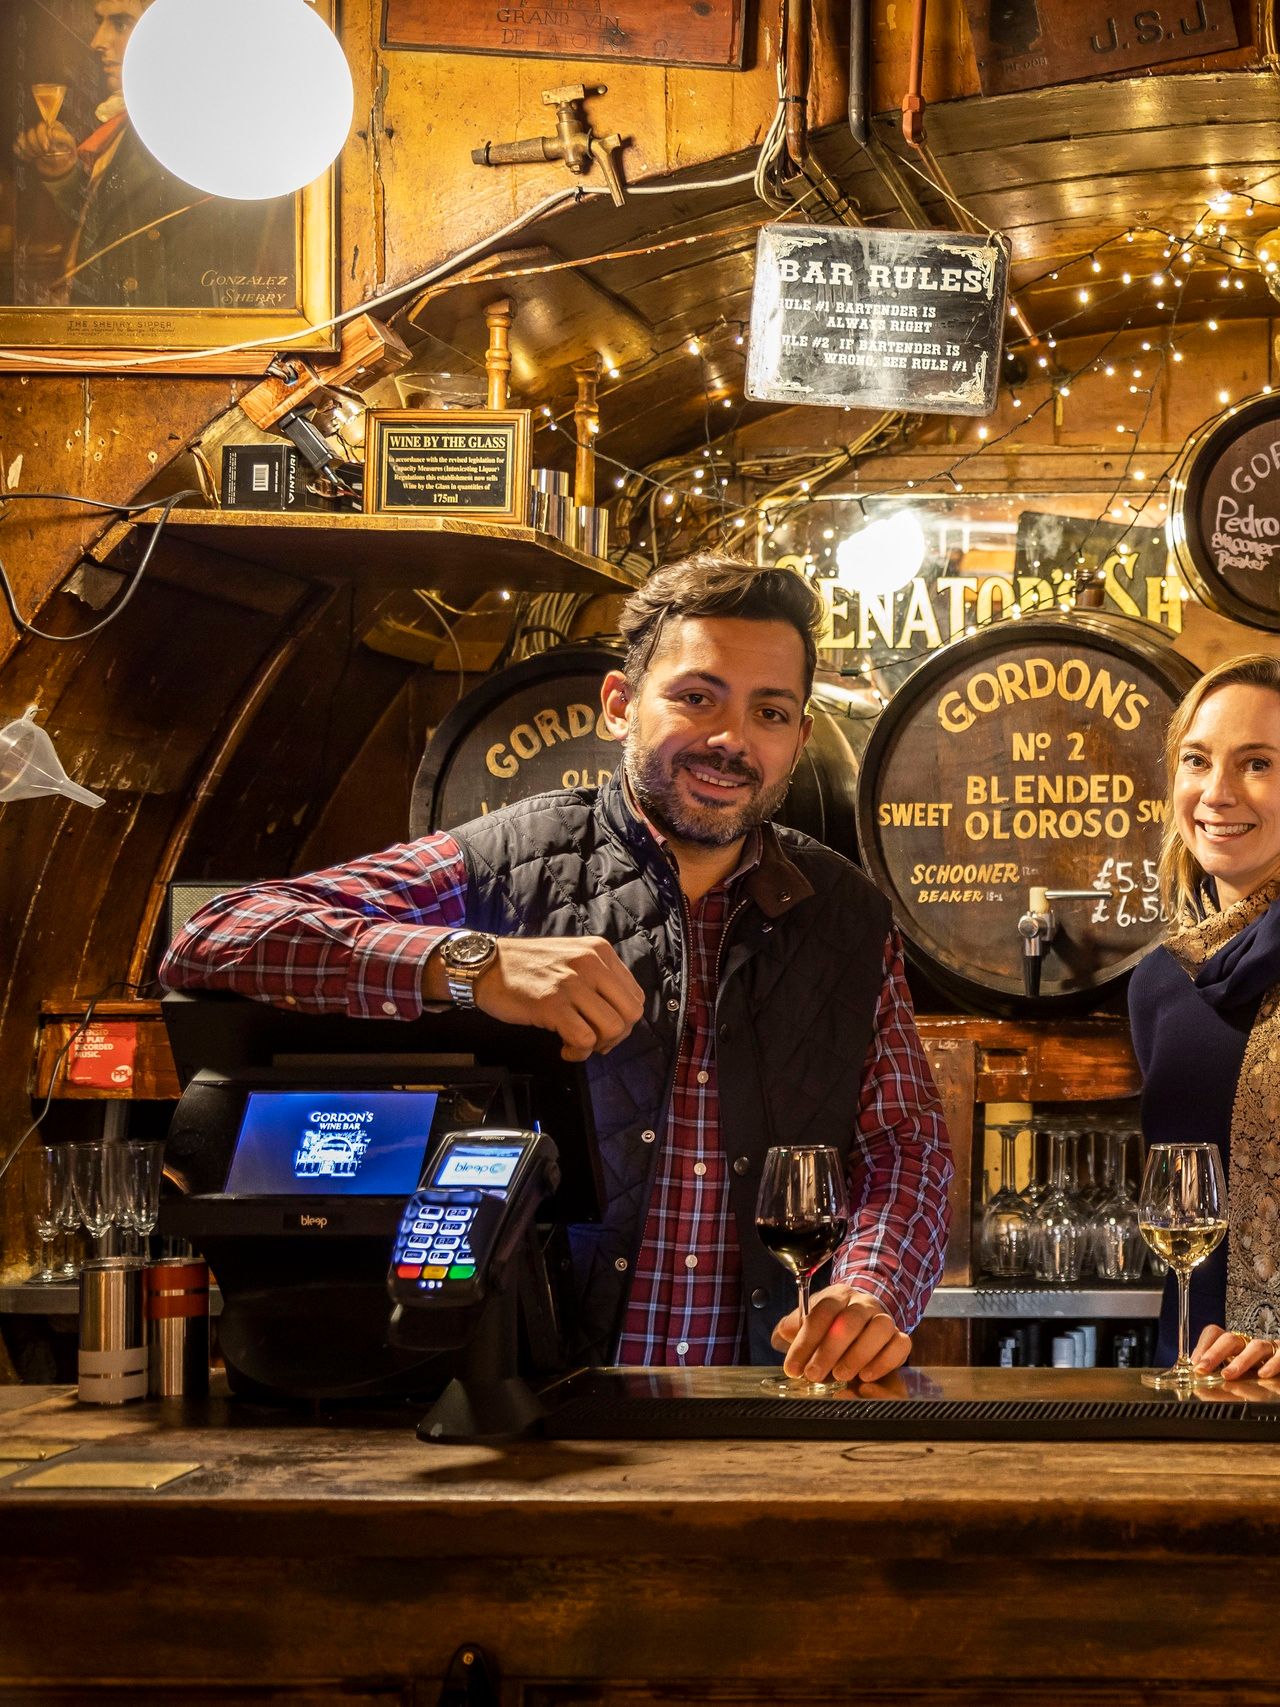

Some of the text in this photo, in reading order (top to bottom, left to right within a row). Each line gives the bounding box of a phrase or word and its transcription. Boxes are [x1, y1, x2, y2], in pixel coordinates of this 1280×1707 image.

[201, 269, 288, 287] GONZALEZ
[778, 258, 983, 294] BAR RULES
[221, 288, 287, 305] SHERRY
[835, 301, 918, 318] BARTENDER
[922, 306, 937, 318] IS
[826, 316, 933, 334] ALWAYS RIGHT
[812, 336, 830, 349] #2
[839, 338, 855, 349] IF
[858, 339, 942, 356] BARTENDER
[945, 345, 961, 357] IS
[882, 356, 908, 370] SEE
[911, 358, 949, 372] RULE
[951, 360, 968, 373] #1
[389, 436, 506, 449] WINE BY THE GLASS
[448, 456, 468, 464] revised
[468, 456, 496, 465] legislation
[288, 454, 297, 504] VINTURI
[436, 474, 473, 482] establishment
[417, 483, 425, 491] by
[457, 483, 482, 491] quantities
[432, 494, 459, 504] 175ml
[1215, 495, 1280, 539] Pedro
[937, 657, 1150, 734] GORDON'S
[1066, 731, 1086, 762] 2
[966, 774, 1135, 805] BLENDED
[878, 802, 953, 828] SWEET
[964, 808, 1131, 841] OLOROSO
[910, 862, 1021, 886] SCHOONER
[1093, 857, 1161, 894] £5.5
[917, 889, 984, 904] BEAKER
[74, 1043, 114, 1051] RECORDED
[86, 1036, 105, 1044] PLAY
[310, 1111, 375, 1123] GORDON'S
[319, 1122, 361, 1131] WINE BAR
[301, 1214, 328, 1229] bleep
